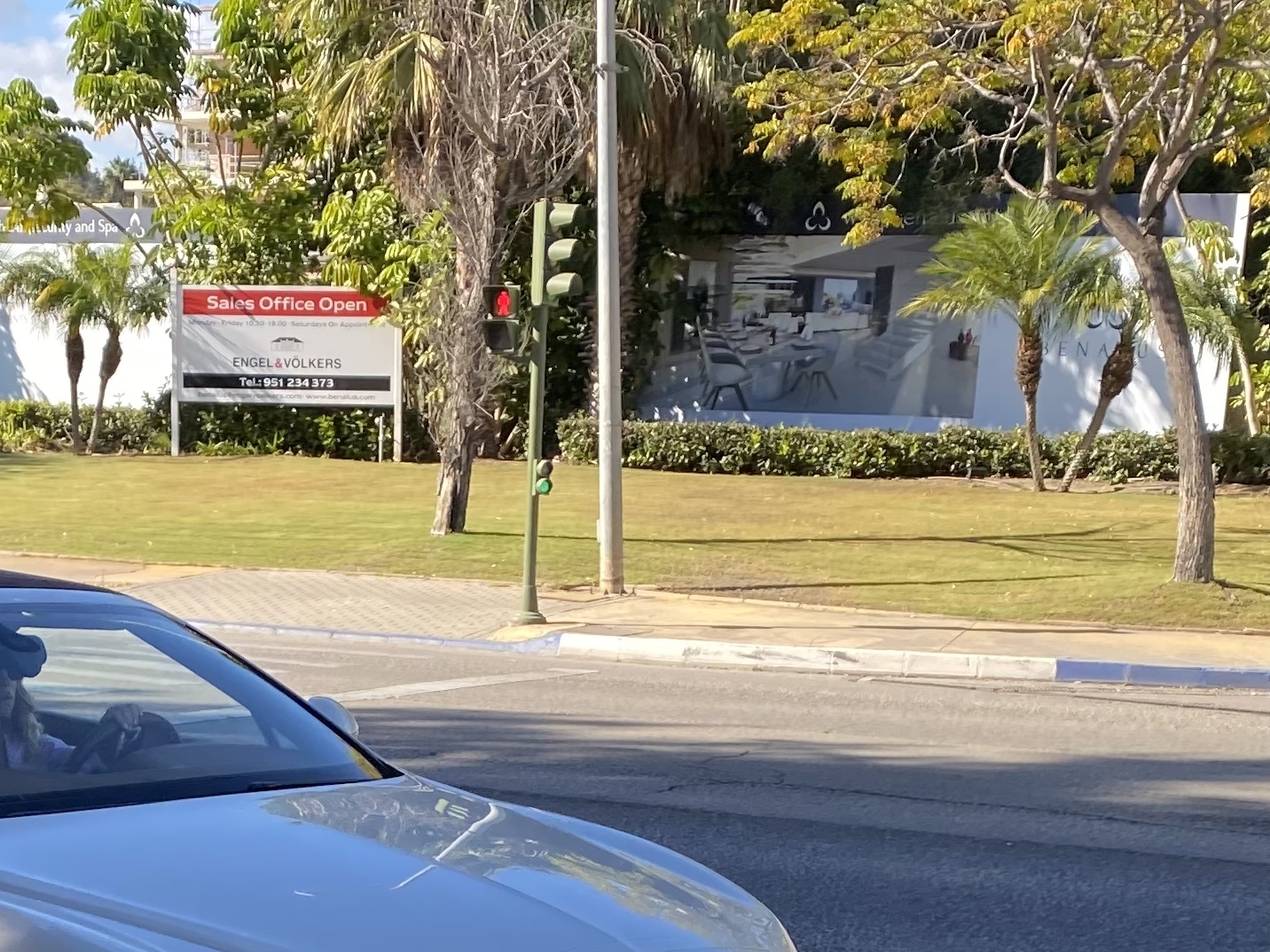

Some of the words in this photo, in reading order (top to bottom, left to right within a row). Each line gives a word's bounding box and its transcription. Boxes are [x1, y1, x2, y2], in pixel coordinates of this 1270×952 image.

[75, 220, 95, 233] and
[98, 219, 118, 236] Spa
[207, 295, 255, 310] Sales
[259, 296, 315, 311] Office
[319, 297, 367, 313] Open
[263, 378, 283, 387] 951
[287, 378, 309, 388] 234
[311, 379, 334, 388] 373
